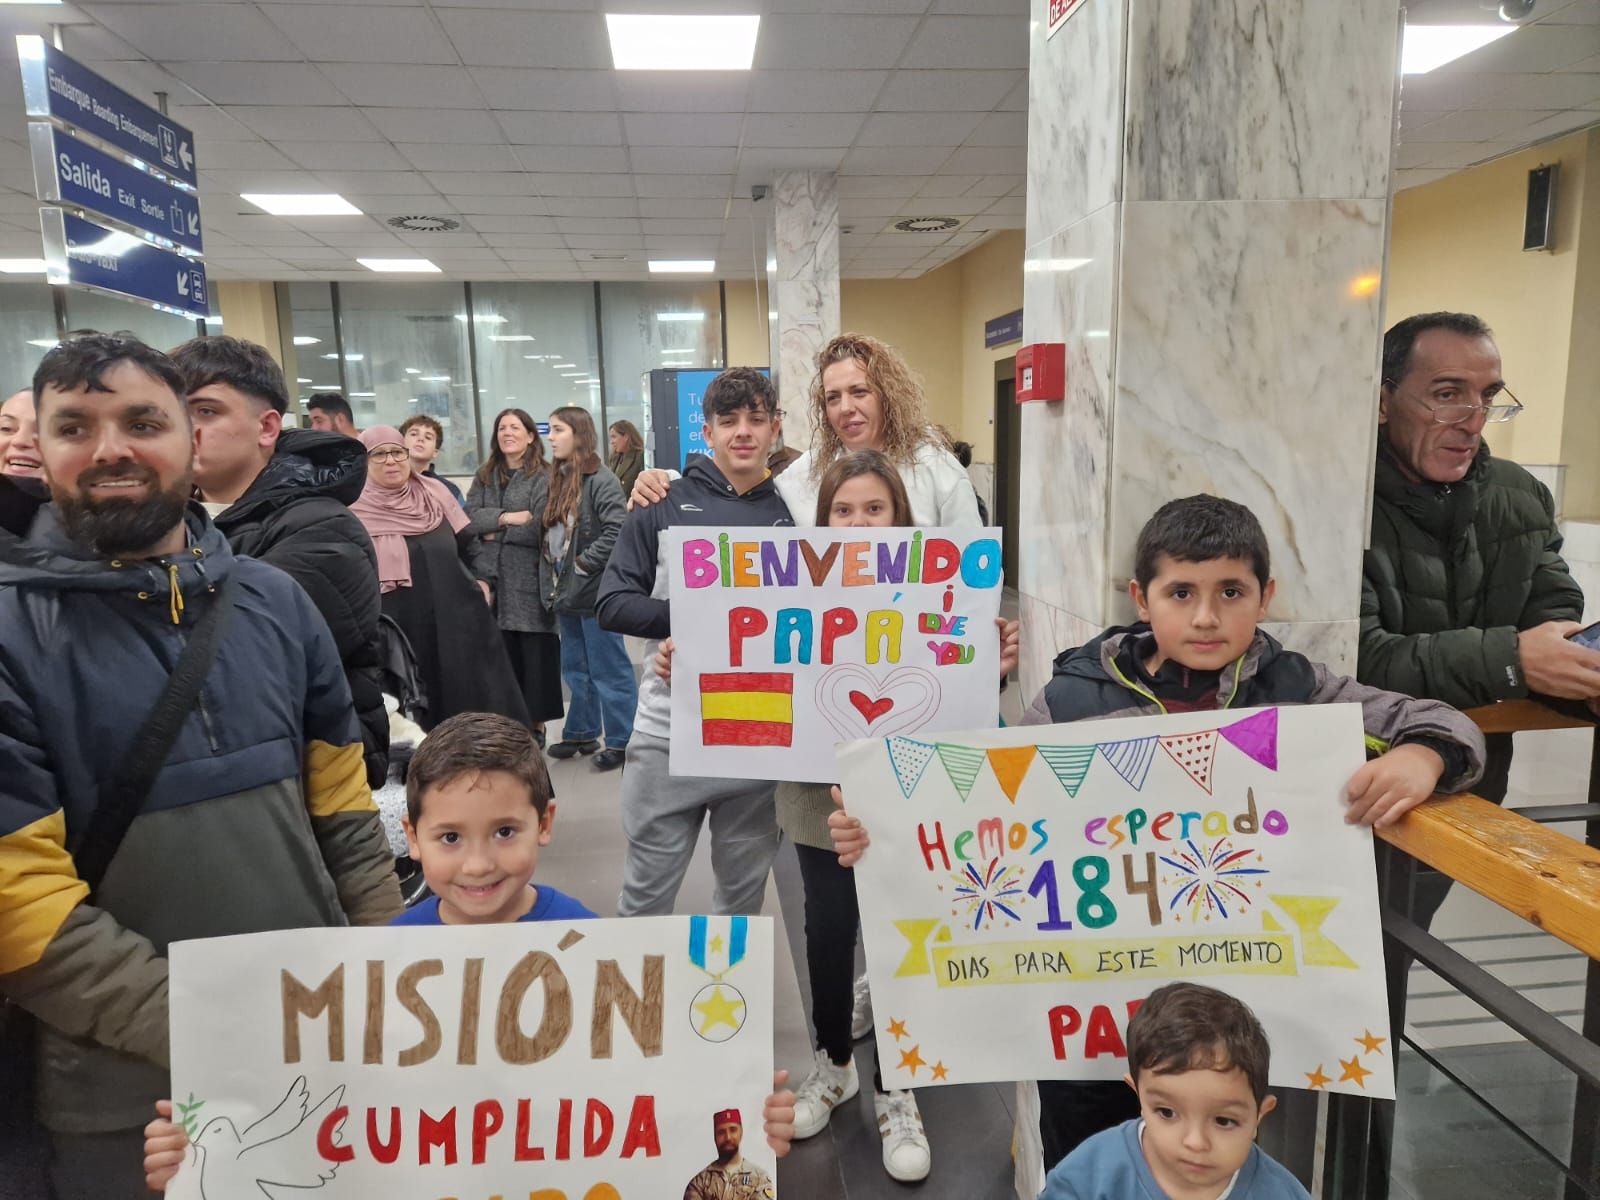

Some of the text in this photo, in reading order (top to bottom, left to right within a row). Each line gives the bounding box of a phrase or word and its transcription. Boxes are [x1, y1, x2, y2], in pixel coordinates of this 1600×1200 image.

[48, 67, 91, 111] Embarque
[60, 153, 165, 221] Salida Exit Sortie
[728, 591, 904, 667] PAPÁ
[918, 612, 968, 636] LOVE
[926, 640, 975, 666] YOU
[917, 786, 1289, 872] Hemos esperado
[1027, 851, 1163, 931] 184
[947, 940, 1283, 981] DIAS PARA ESTE MOMENTO
[281, 929, 665, 1067] MISIÓN
[1048, 999, 1146, 1061] PA
[316, 1095, 663, 1166] CUMPLIDA
